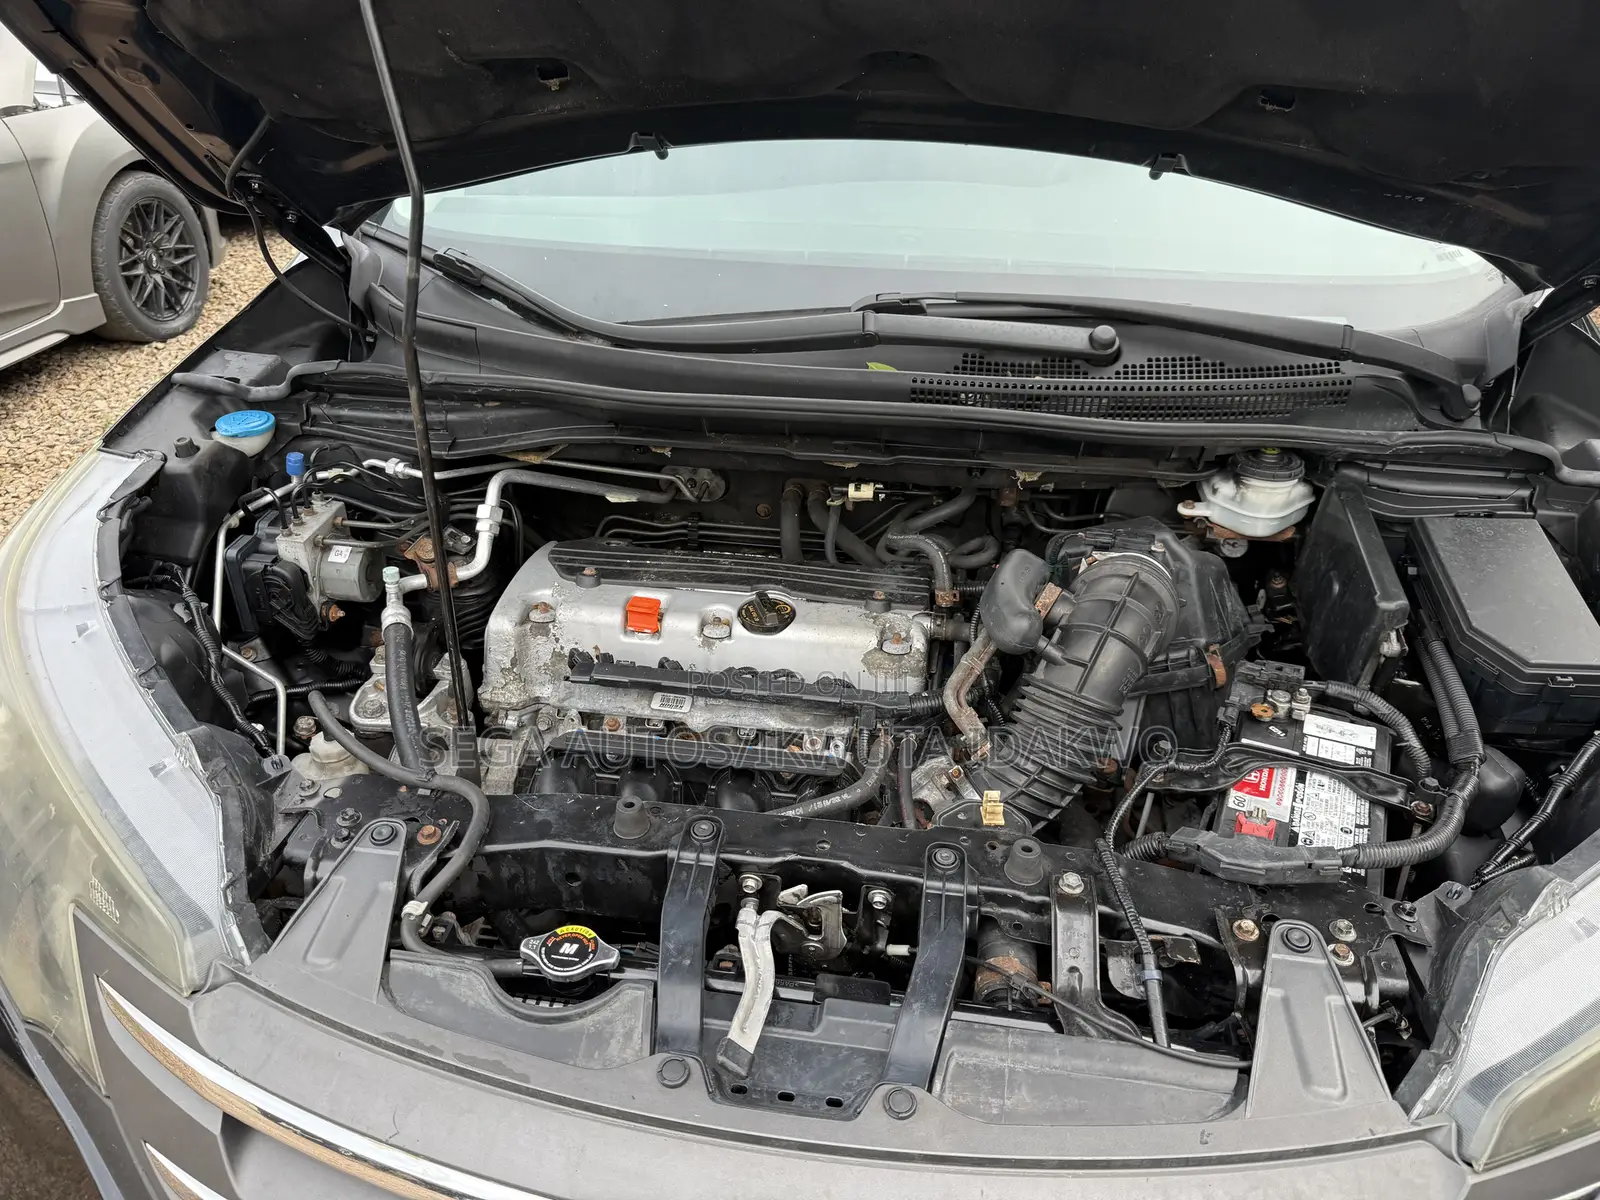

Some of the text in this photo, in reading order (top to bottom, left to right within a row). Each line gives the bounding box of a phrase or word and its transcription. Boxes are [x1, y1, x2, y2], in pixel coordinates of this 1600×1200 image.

[1259, 767, 1270, 792] HONDA
[1232, 795, 1247, 808] 60
[566, 926, 593, 937] CAUTION
